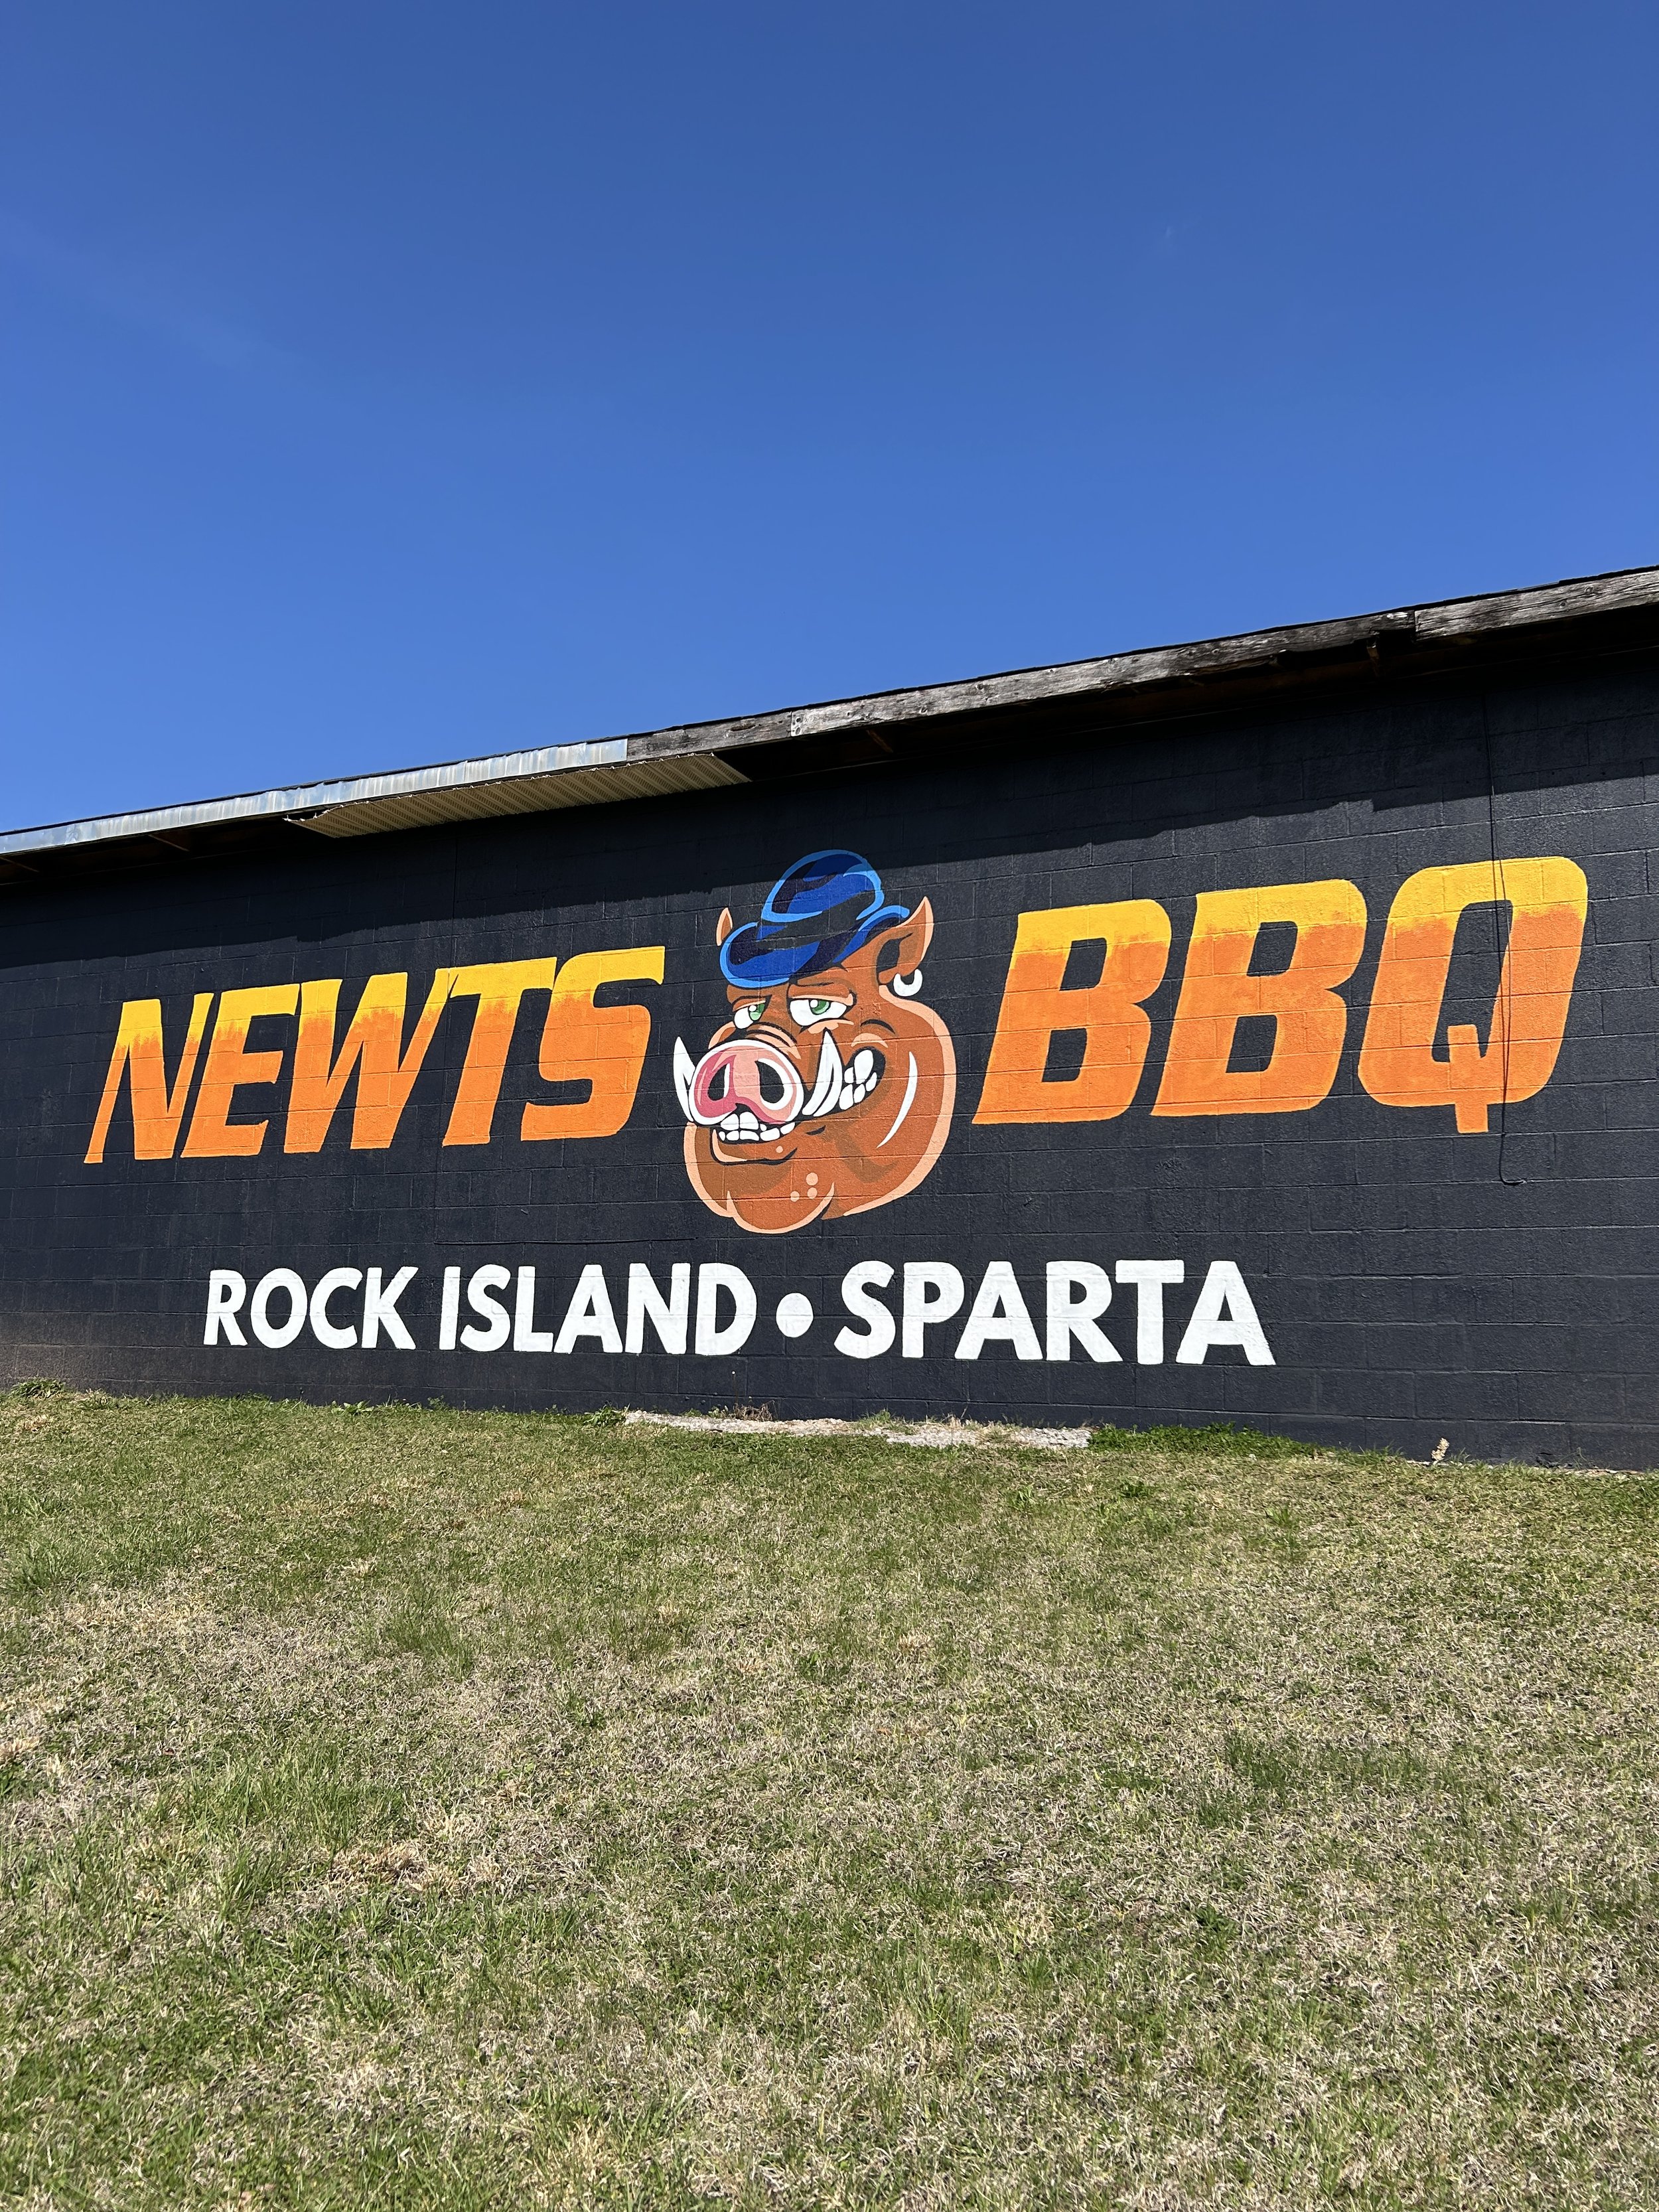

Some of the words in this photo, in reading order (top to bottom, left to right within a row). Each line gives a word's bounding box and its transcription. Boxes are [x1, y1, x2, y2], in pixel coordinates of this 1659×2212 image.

[84, 946, 665, 1163] NEWTS
[972, 856, 1589, 1132] BBQ
[203, 1266, 419, 1350] ROCK
[439, 1263, 757, 1356] ISLAND
[834, 1260, 1276, 1366] SPARTA
